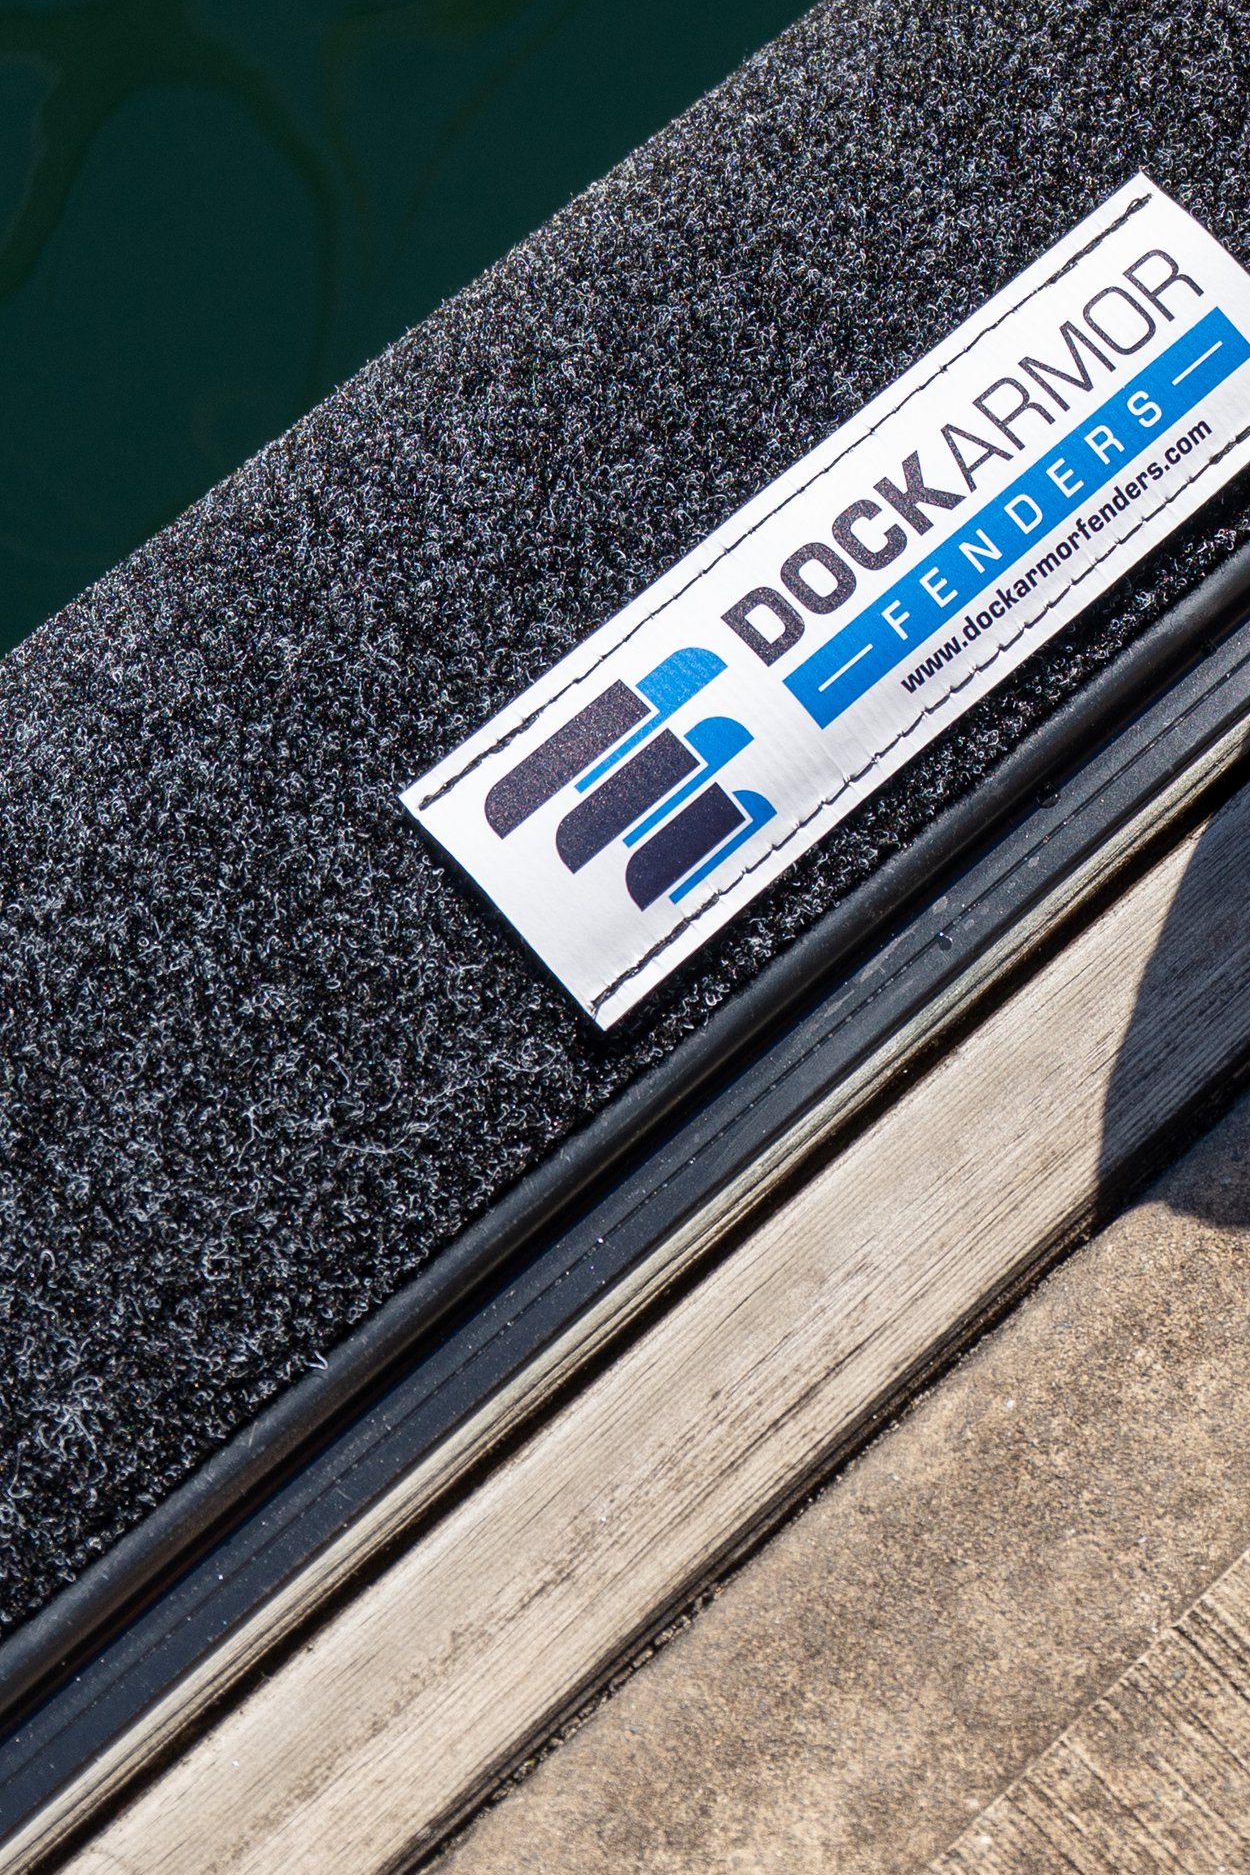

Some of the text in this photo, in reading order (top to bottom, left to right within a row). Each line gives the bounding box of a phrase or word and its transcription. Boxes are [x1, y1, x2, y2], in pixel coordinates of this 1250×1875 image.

[719, 248, 1205, 667] DOCKARMOR
[880, 389, 1163, 640] FENDERS
[899, 416, 1213, 694] www.dockarmorfenders.com
